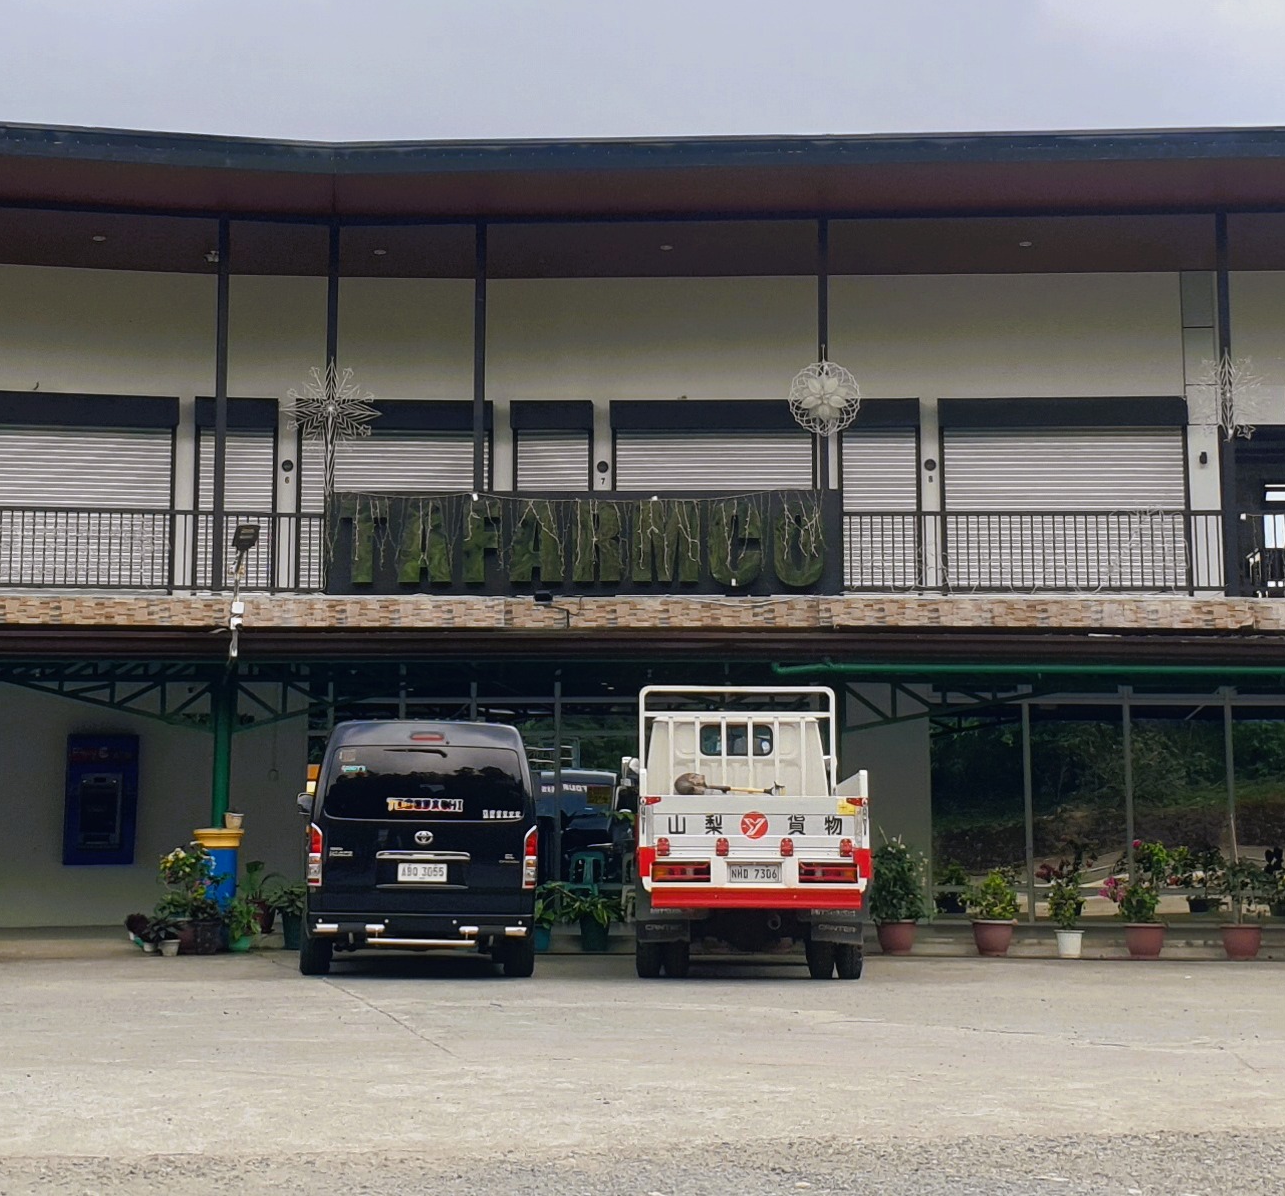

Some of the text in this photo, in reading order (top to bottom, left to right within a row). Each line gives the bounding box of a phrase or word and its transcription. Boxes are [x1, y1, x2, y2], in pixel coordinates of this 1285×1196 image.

[340, 499, 825, 587] TAFARMCO
[421, 866, 445, 877] 3055
[754, 868, 778, 879] 7306
